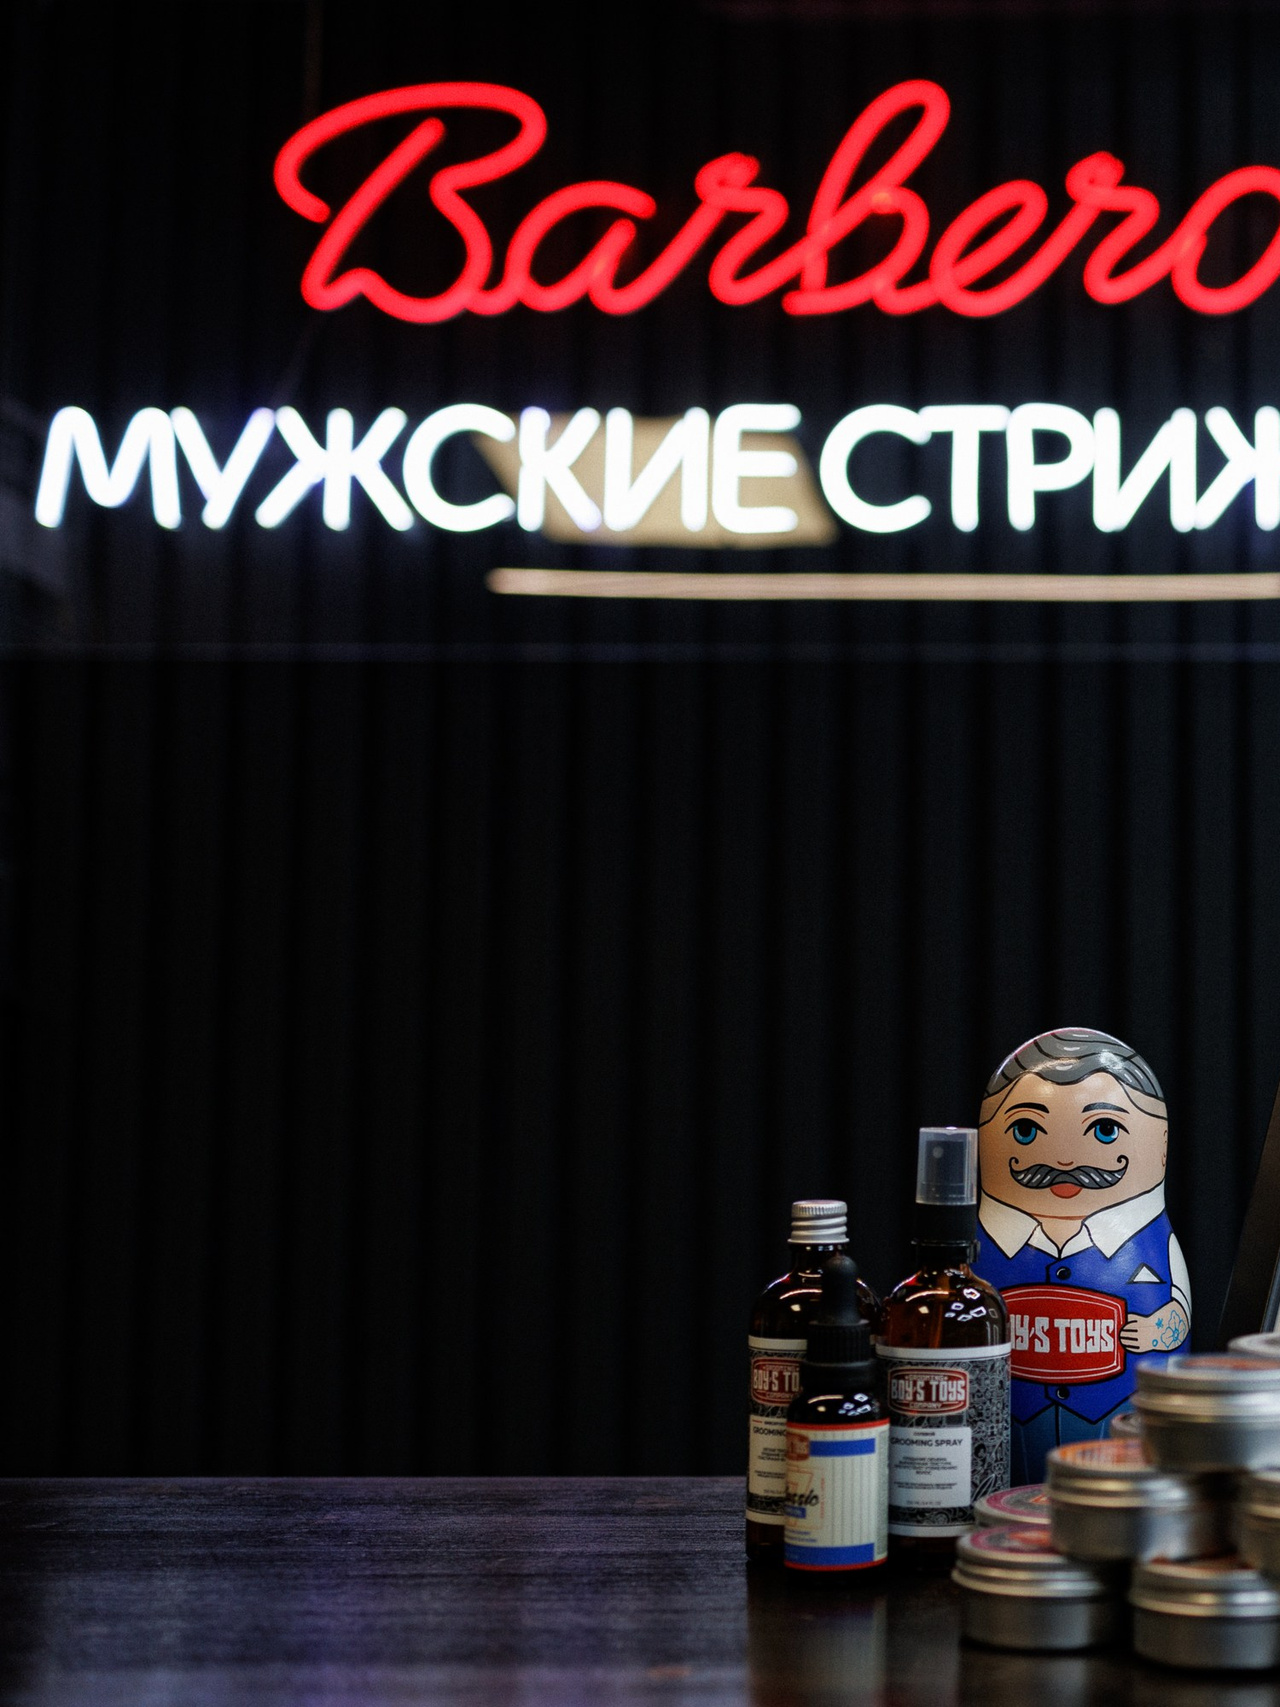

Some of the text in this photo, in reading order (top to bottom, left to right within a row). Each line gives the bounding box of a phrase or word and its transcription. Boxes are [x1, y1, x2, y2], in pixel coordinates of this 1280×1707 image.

[35, 403, 803, 533] МУЖСКИЕ
[1054, 1318, 1115, 1353] TOYS
[753, 1369, 800, 1392] BOY'S TO
[891, 1379, 965, 1401] BOY'S TOYS
[890, 1438, 964, 1447] GROOMING SPRAY
